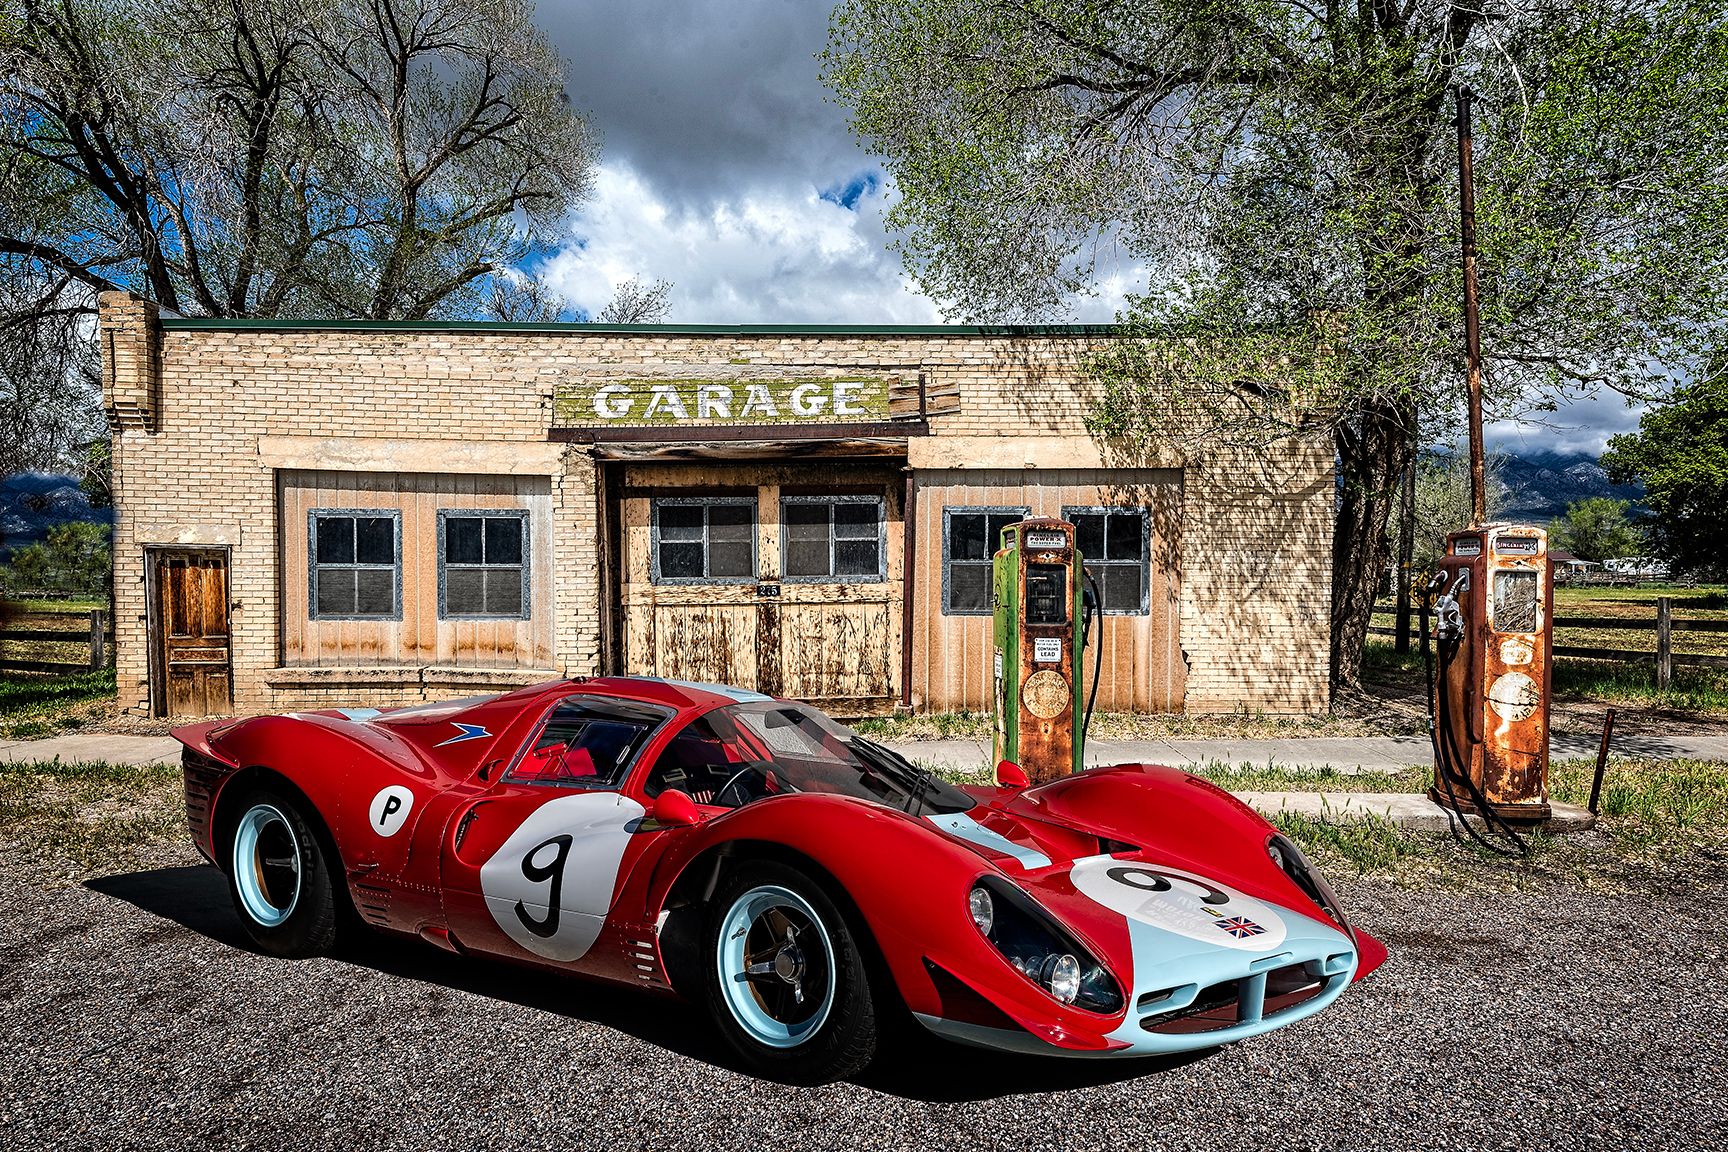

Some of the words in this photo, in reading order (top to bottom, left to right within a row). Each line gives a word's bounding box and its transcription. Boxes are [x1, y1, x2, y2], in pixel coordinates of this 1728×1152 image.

[593, 382, 865, 418] GARAGE
[380, 795, 401, 826] P
[514, 834, 574, 938] 9
